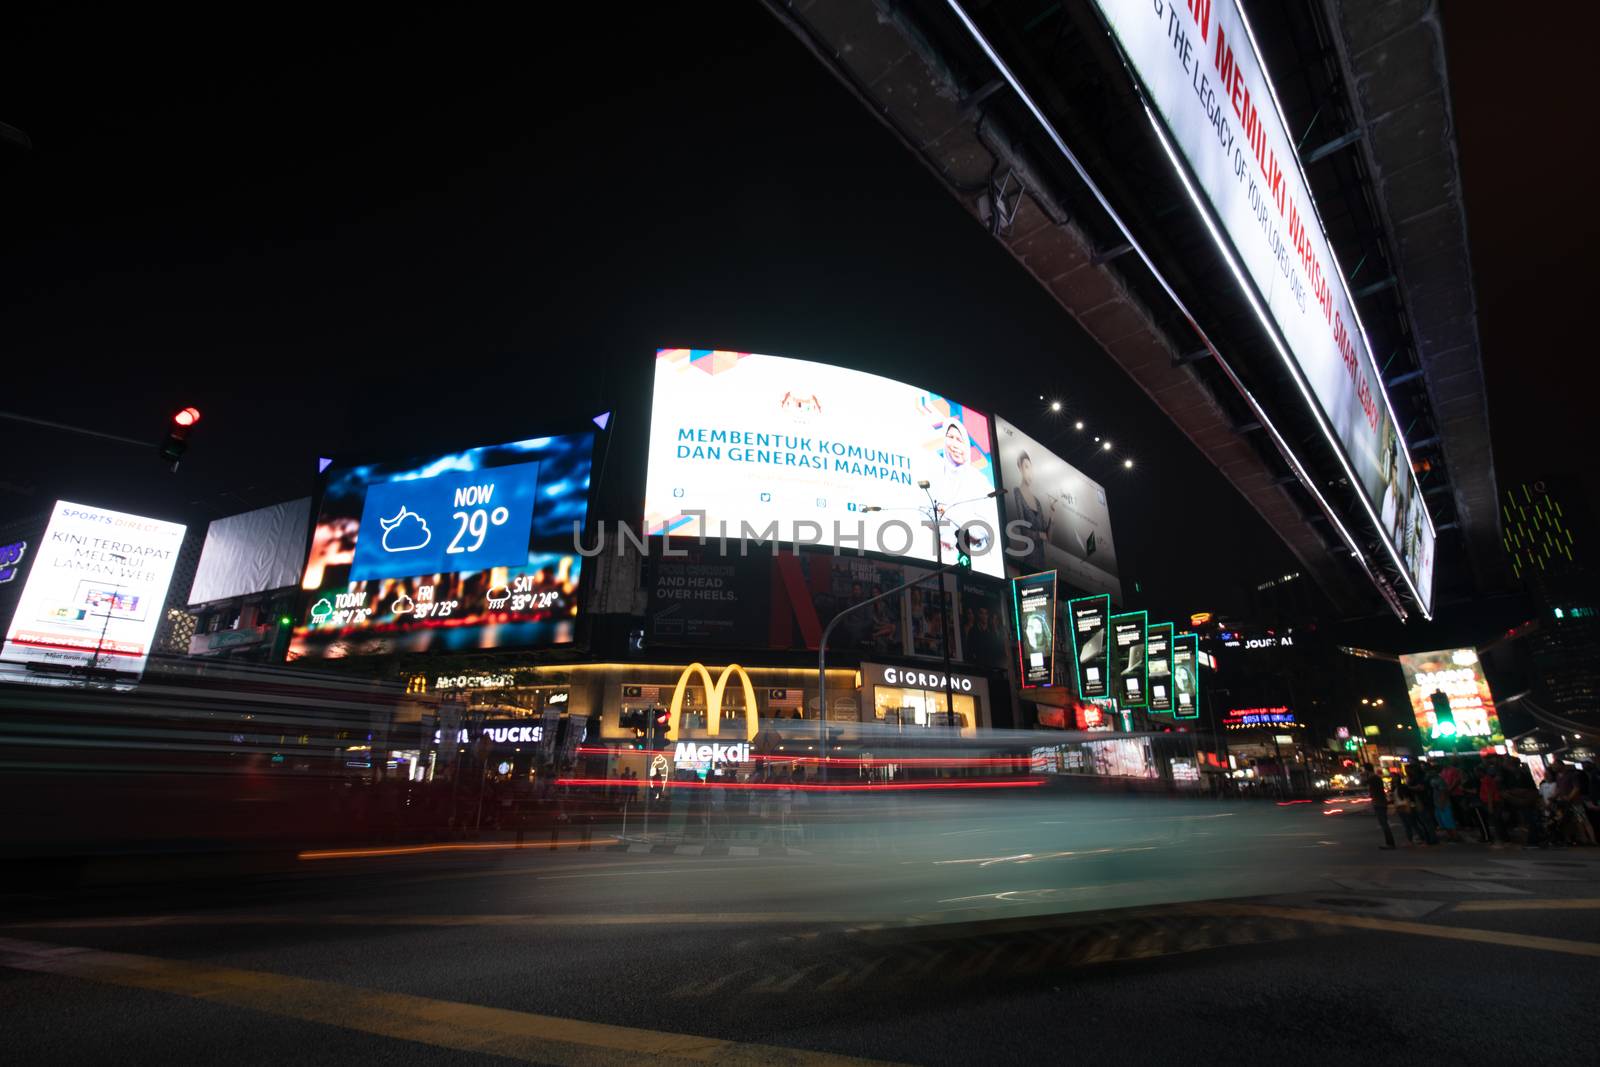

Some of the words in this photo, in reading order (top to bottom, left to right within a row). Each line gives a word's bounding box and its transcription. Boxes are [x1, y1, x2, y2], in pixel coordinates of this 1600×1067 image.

[1168, 2, 1193, 75] THE
[1193, 60, 1234, 157] LEGACY
[1234, 148, 1248, 183] OF
[1247, 173, 1269, 226] YOUR
[1268, 221, 1291, 279] LOVED
[1290, 268, 1306, 314] ONES
[1214, 22, 1287, 218] MEMILIKI
[1289, 196, 1334, 324] WARISAN
[1334, 311, 1360, 385] SMART
[677, 428, 813, 452] MEMBENTUK
[819, 440, 912, 470] KOMUNITI
[676, 445, 721, 461] DAN
[727, 447, 828, 471] GENERASI
[834, 459, 913, 486] MAMPAN
[453, 483, 495, 508] NOW
[51, 531, 88, 546] KINI
[93, 537, 174, 560] TERDAPAT
[53, 557, 114, 576] LAMAN
[513, 575, 535, 593] SAT
[657, 576, 686, 587] AND
[688, 577, 723, 588] HEAD
[335, 592, 367, 609] TODAY
[417, 586, 434, 602] FRI
[656, 588, 692, 600] OVER
[694, 589, 738, 601] HEELS.
[884, 667, 973, 692] GIORDANO
[673, 742, 750, 763] Mekdi
